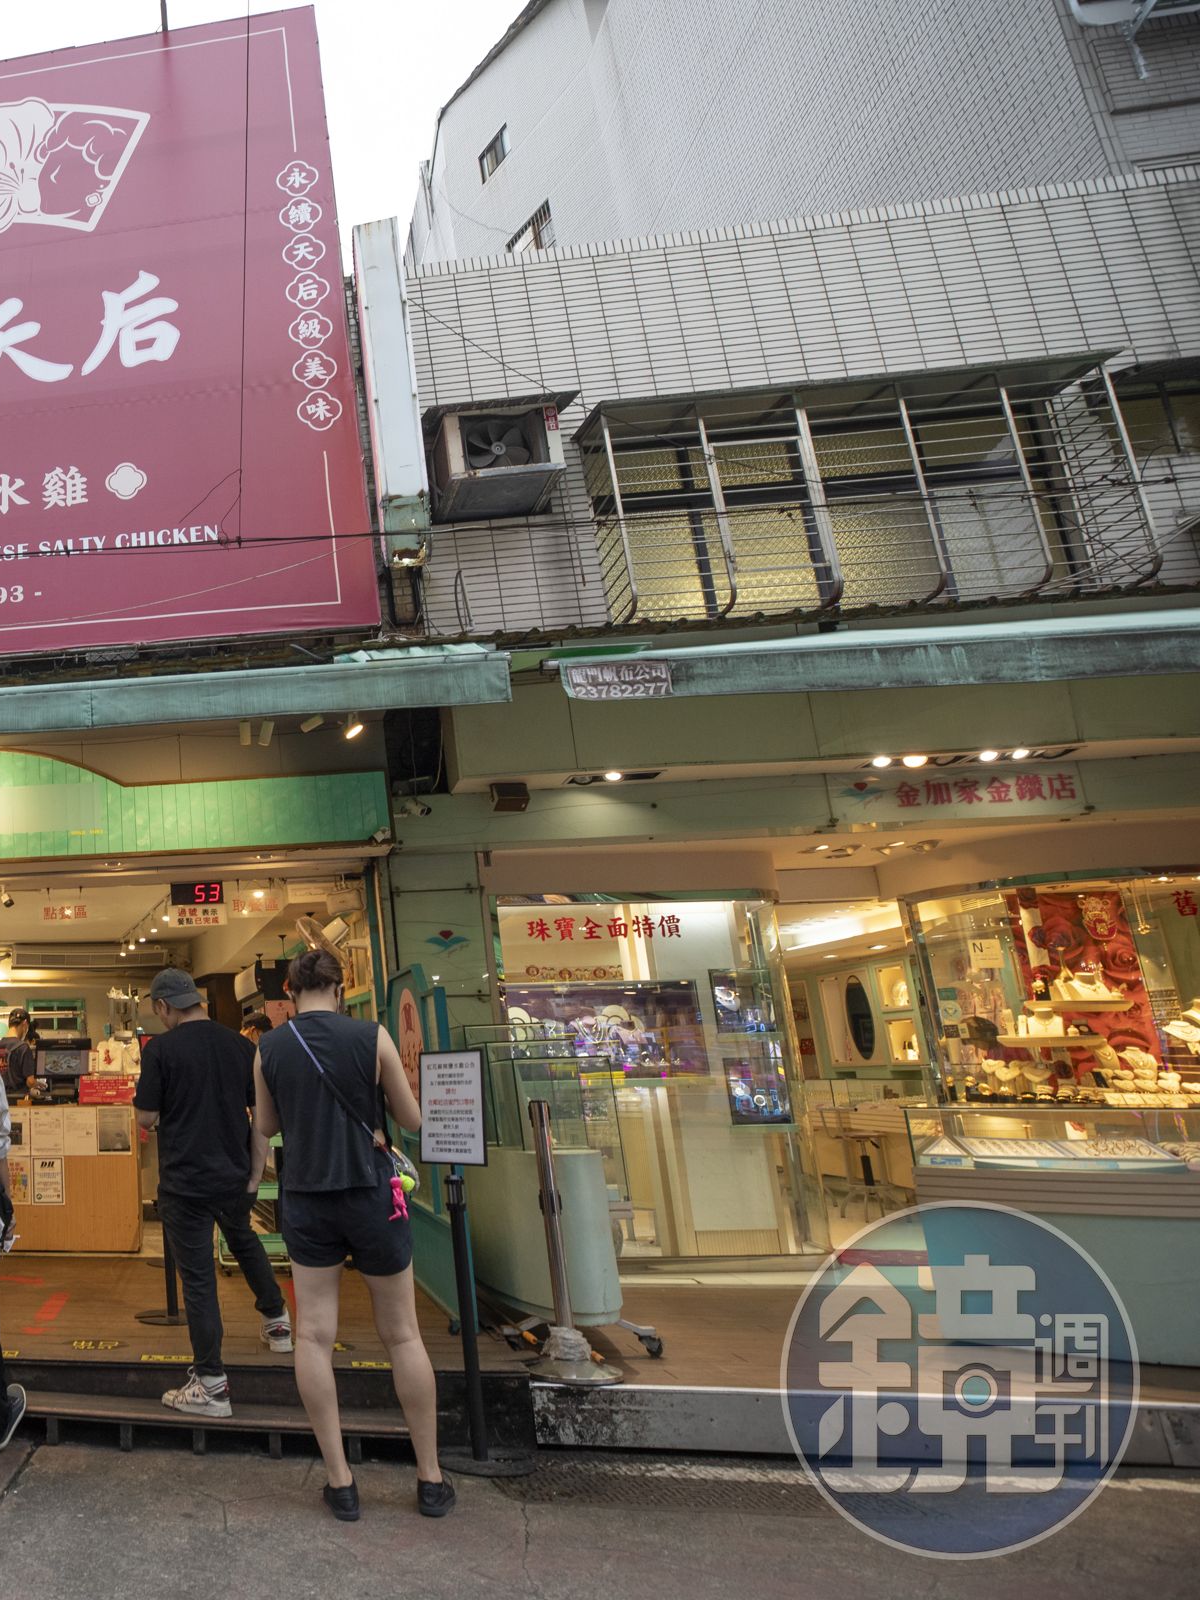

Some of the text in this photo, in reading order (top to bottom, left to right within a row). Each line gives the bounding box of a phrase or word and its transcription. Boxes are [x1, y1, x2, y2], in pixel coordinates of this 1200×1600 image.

[286, 168, 333, 421] 永續天后級美味
[38, 534, 106, 558] SALTY
[115, 524, 219, 548] CHICKEN
[575, 682, 668, 698] 23782277
[895, 773, 1077, 808] 金加家金鑽店
[194, 883, 221, 902] 53
[43, 904, 88, 921] 點餐區
[527, 914, 682, 942] 珠寶全面特價
